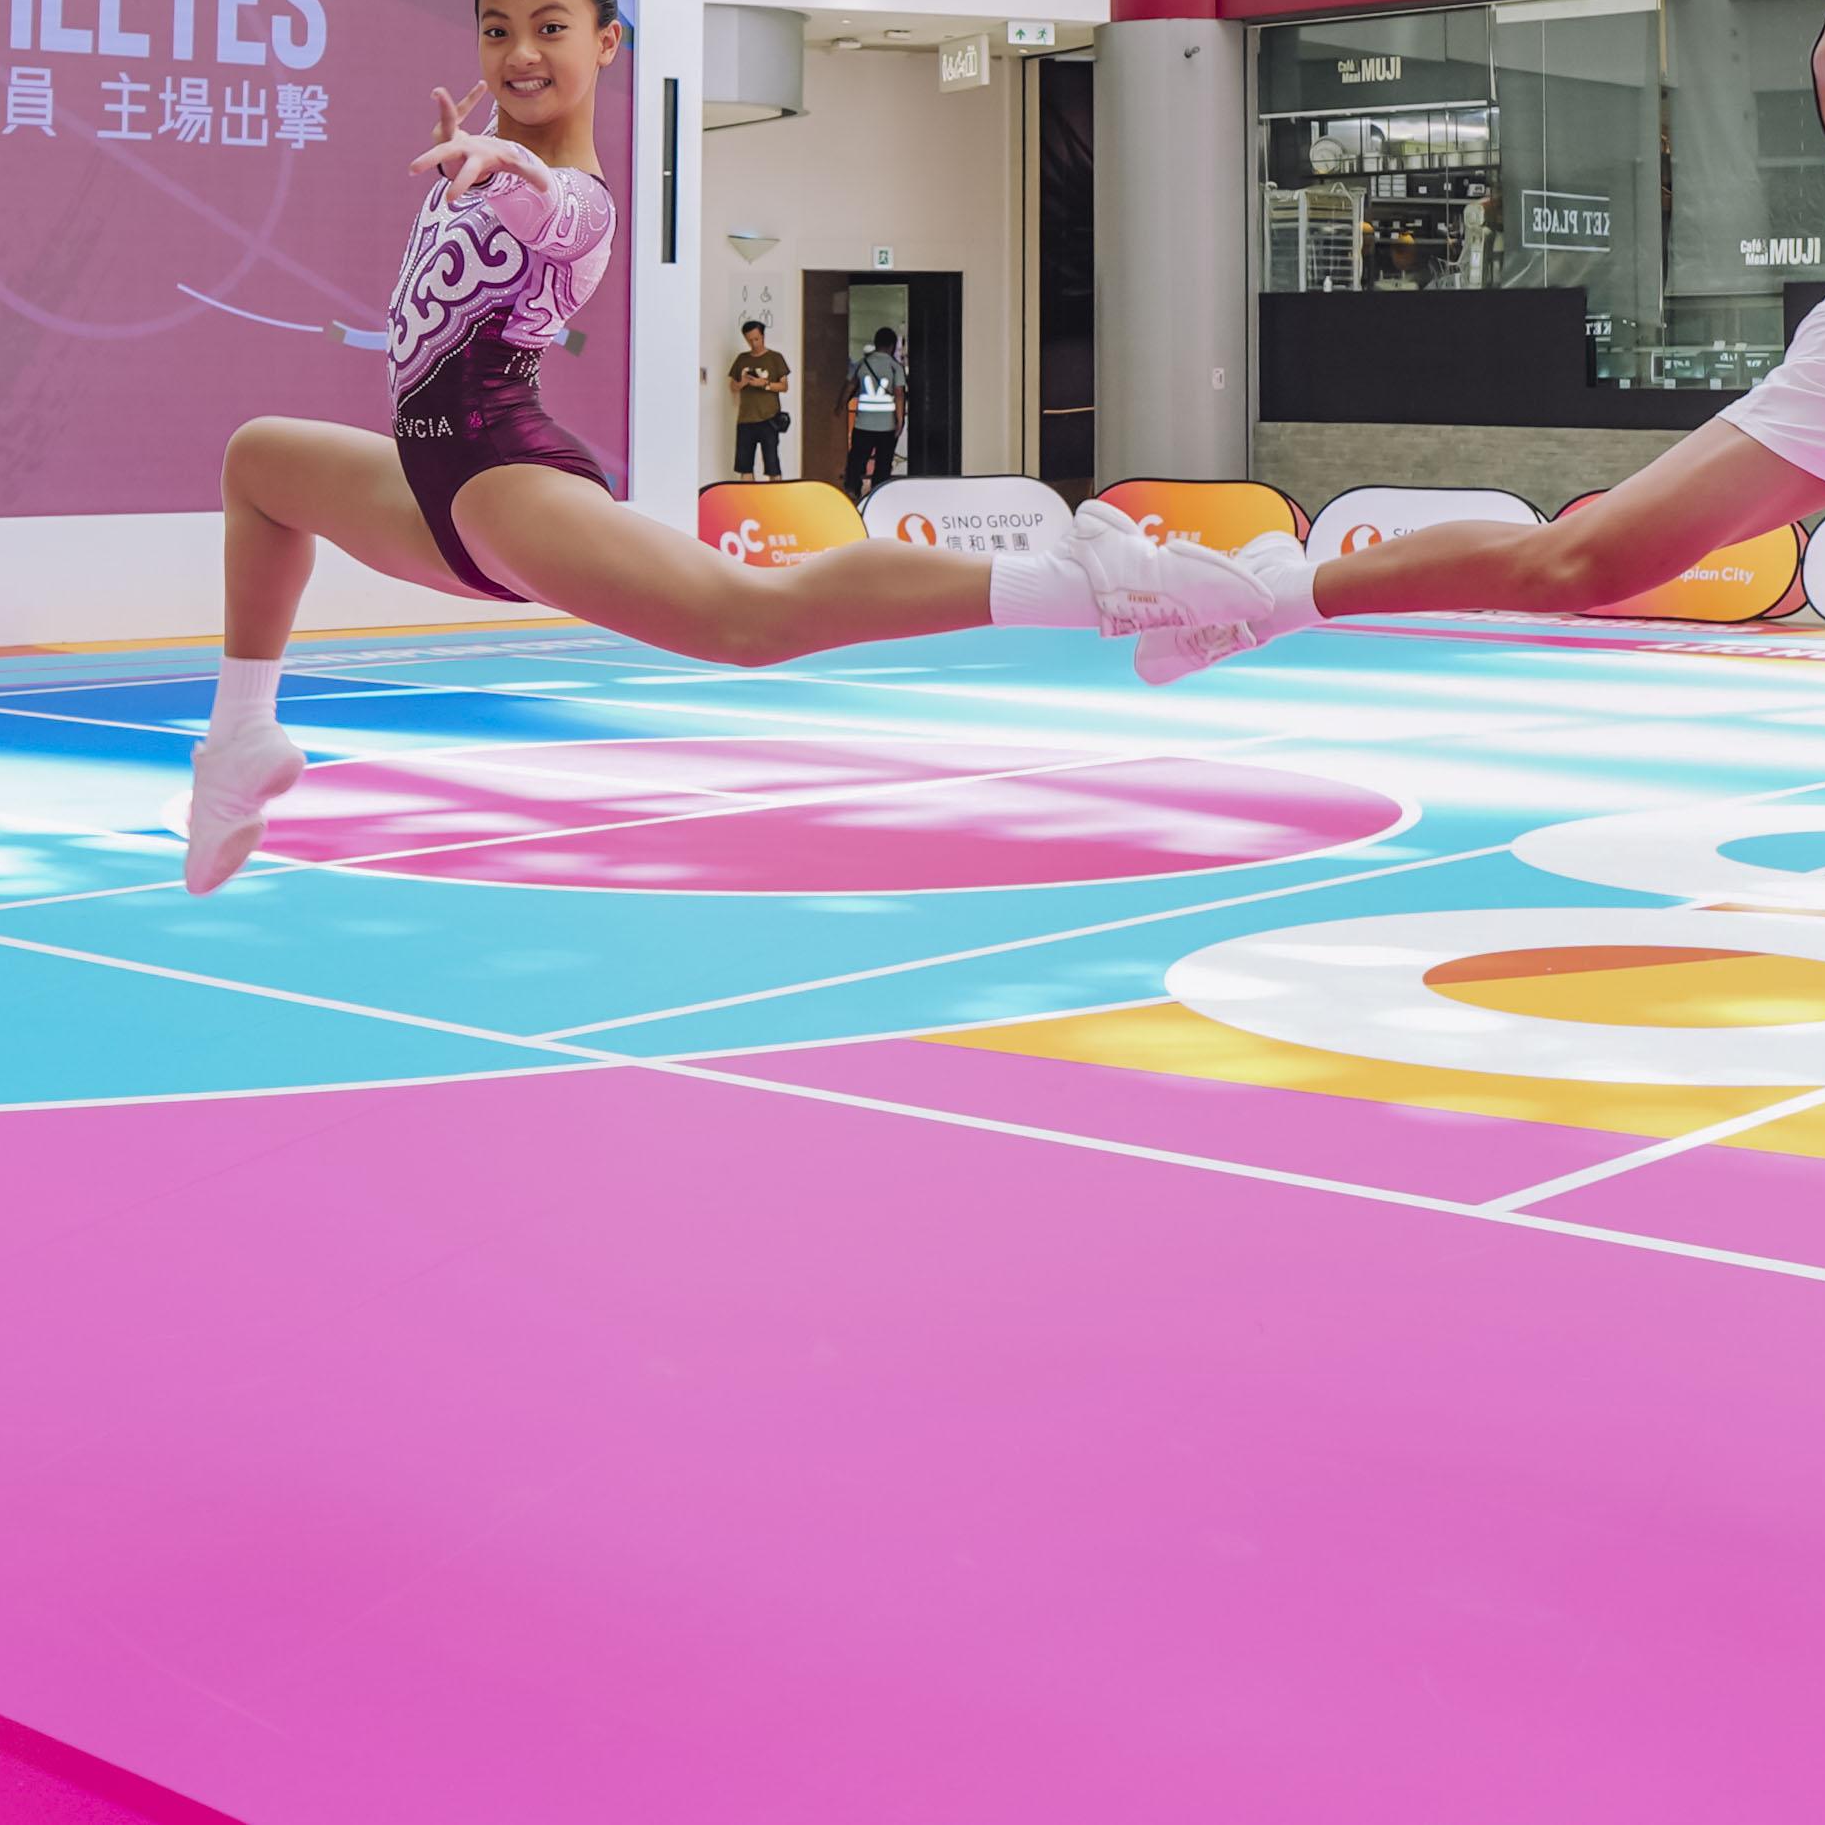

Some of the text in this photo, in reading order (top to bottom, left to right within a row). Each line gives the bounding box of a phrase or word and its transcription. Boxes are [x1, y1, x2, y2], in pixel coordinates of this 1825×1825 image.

[1361, 56, 1401, 82] MUJI
[96, 70, 331, 150] 主場出擊
[1769, 237, 1820, 265] MUJI
[941, 512, 1044, 529] SINO GROUP
[945, 532, 1030, 552] 信和集團
[1722, 567, 1754, 585] City
